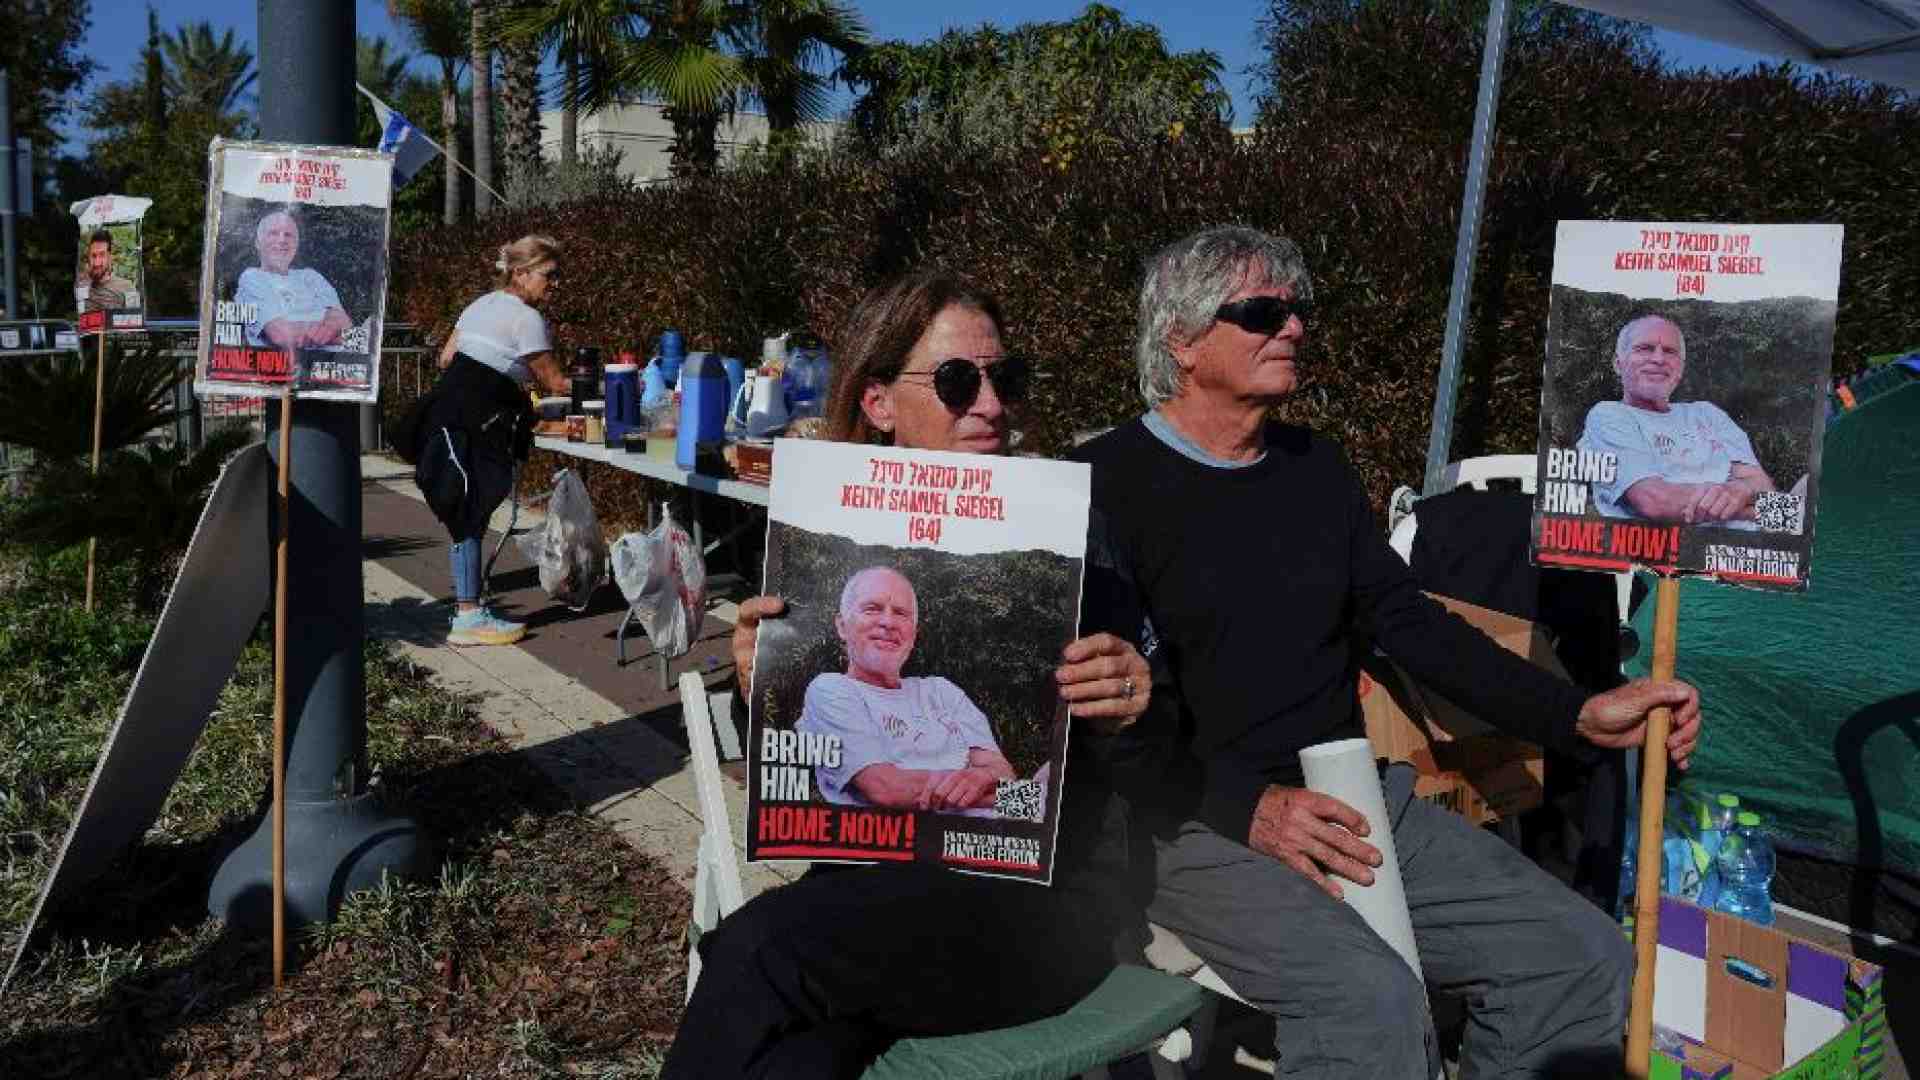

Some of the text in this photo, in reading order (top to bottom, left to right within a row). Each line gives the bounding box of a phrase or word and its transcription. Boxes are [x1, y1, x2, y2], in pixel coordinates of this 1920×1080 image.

[1615, 252, 1763, 274] KEITH SAMUEL SIEGEL
[1546, 448, 1617, 483] BRING
[840, 484, 1005, 521] KEITH SAMUEL SIEGEL
[1543, 482, 1588, 514] HIM
[909, 516, 942, 544] (64)
[1539, 517, 1605, 554] HOME
[1610, 523, 1680, 562] NOW!
[760, 727, 842, 769] BRING
[760, 765, 811, 801] HIM
[758, 806, 832, 842] HOME
[839, 811, 915, 848] NOW!
